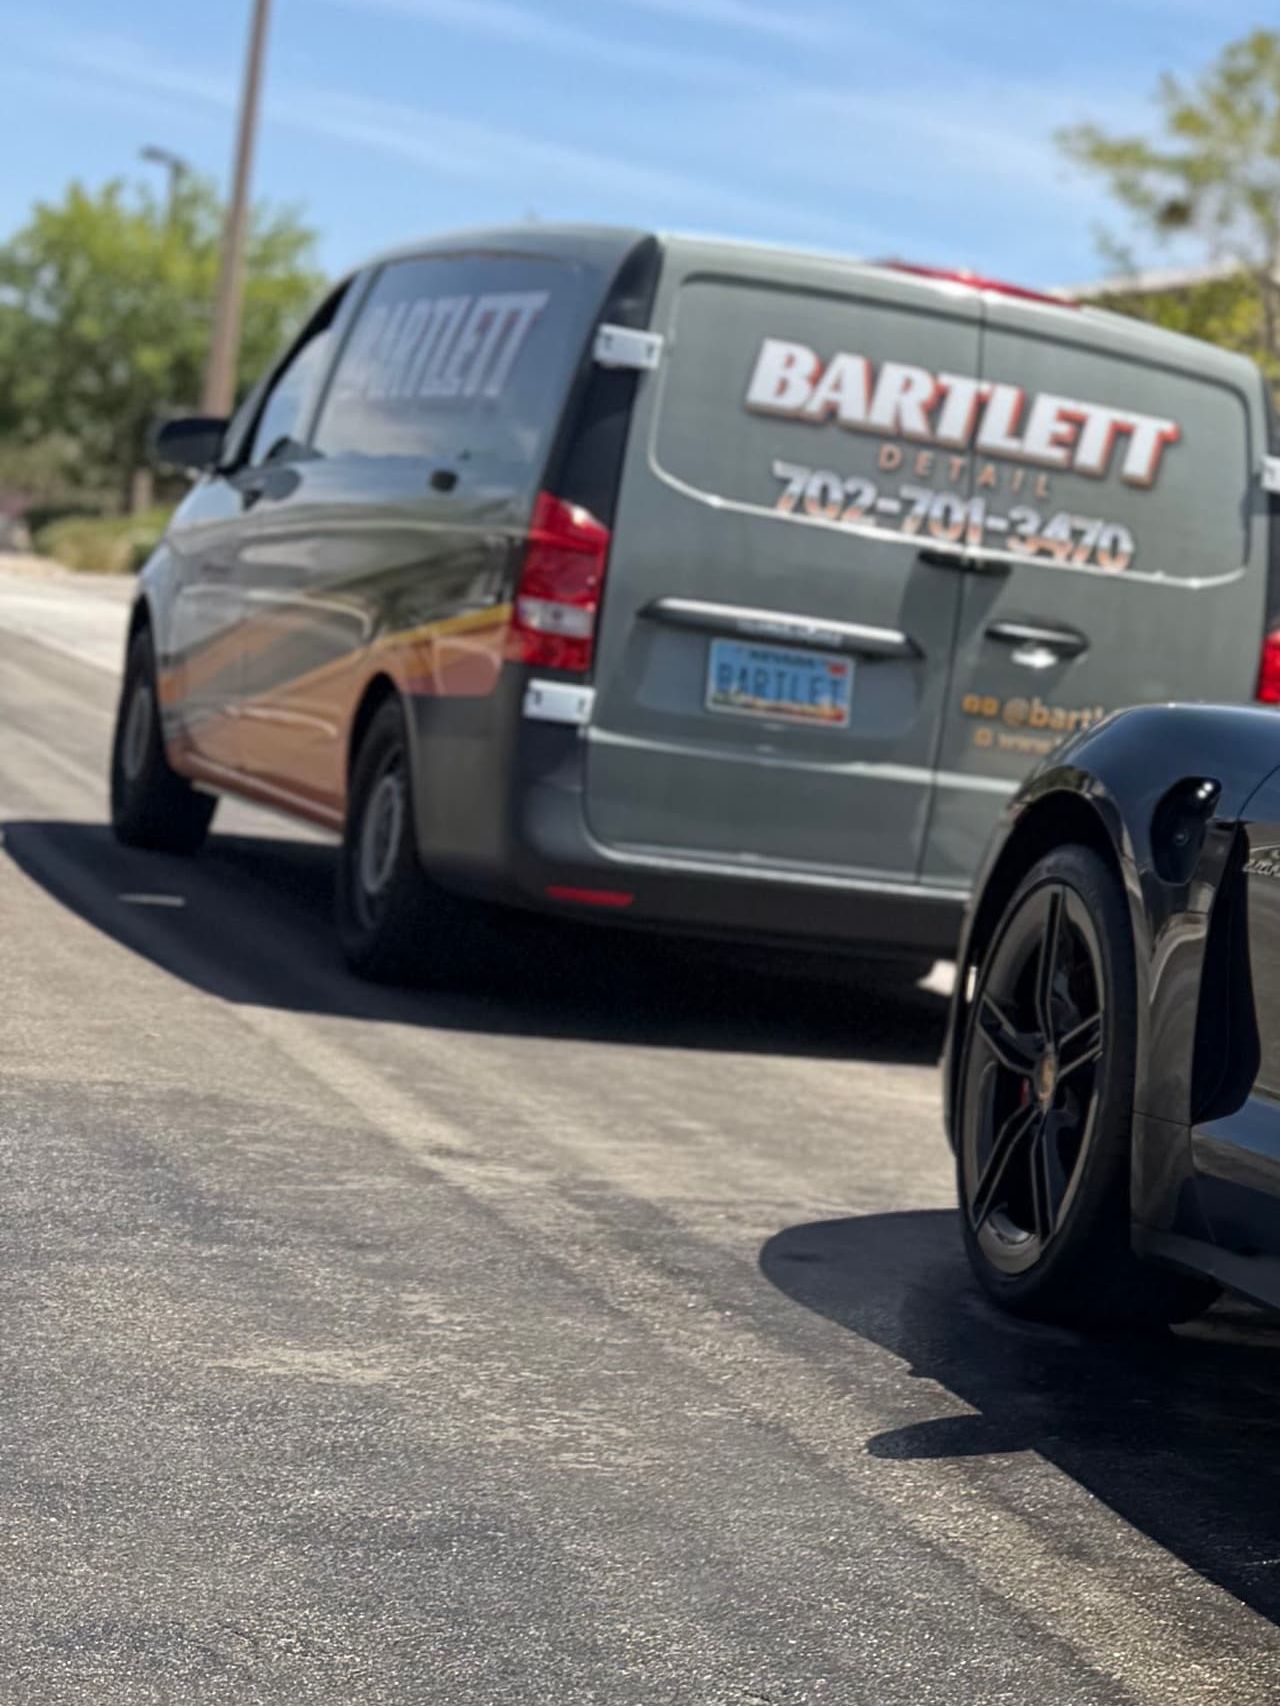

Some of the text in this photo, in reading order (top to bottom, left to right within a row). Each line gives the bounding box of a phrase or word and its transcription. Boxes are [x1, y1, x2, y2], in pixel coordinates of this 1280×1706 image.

[745, 337, 1182, 488] BARTLETT
[771, 458, 1136, 572] 702-701-3470
[877, 443, 1051, 499] DETAIL
